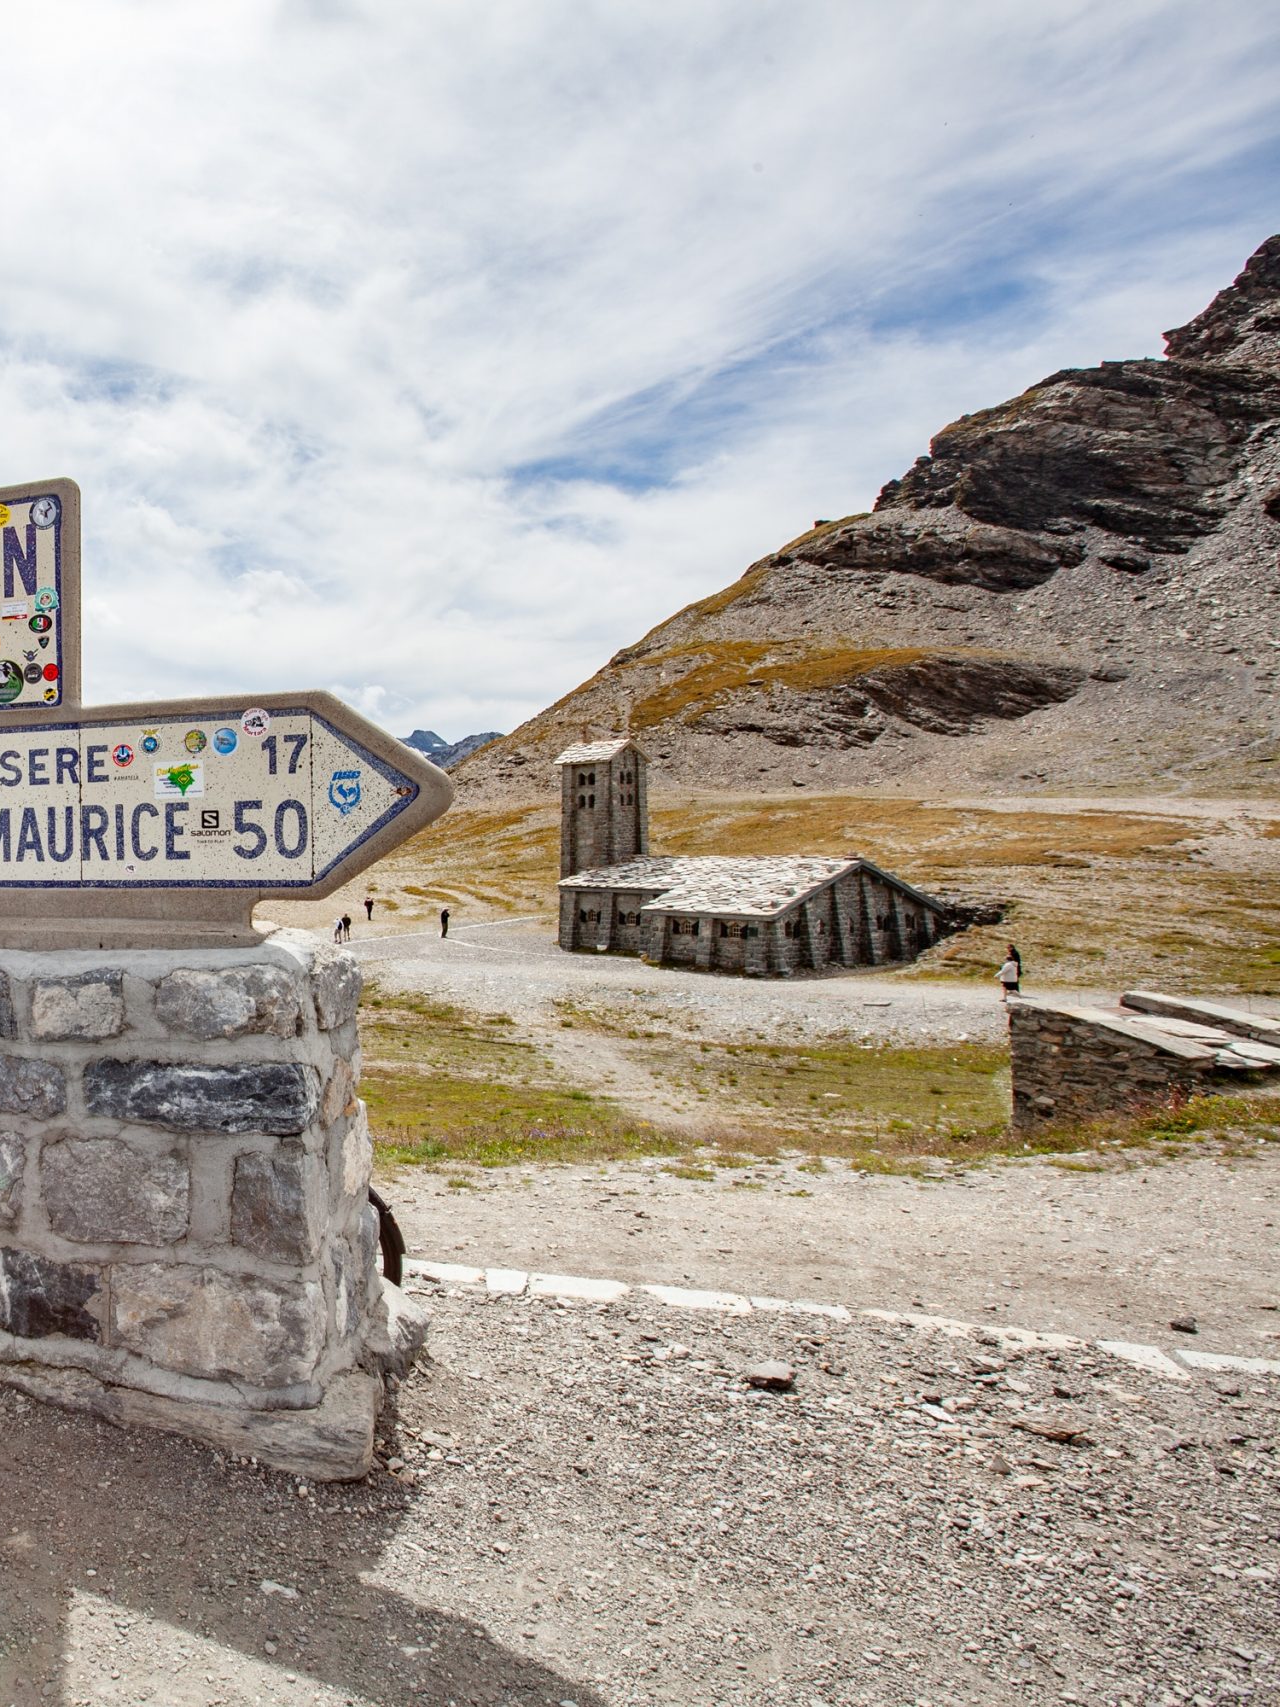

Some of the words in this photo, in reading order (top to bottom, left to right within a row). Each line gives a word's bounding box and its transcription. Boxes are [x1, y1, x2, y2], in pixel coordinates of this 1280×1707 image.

[261, 733, 309, 775] 17
[191, 829, 231, 837] salomon
[233, 799, 309, 860] 50
